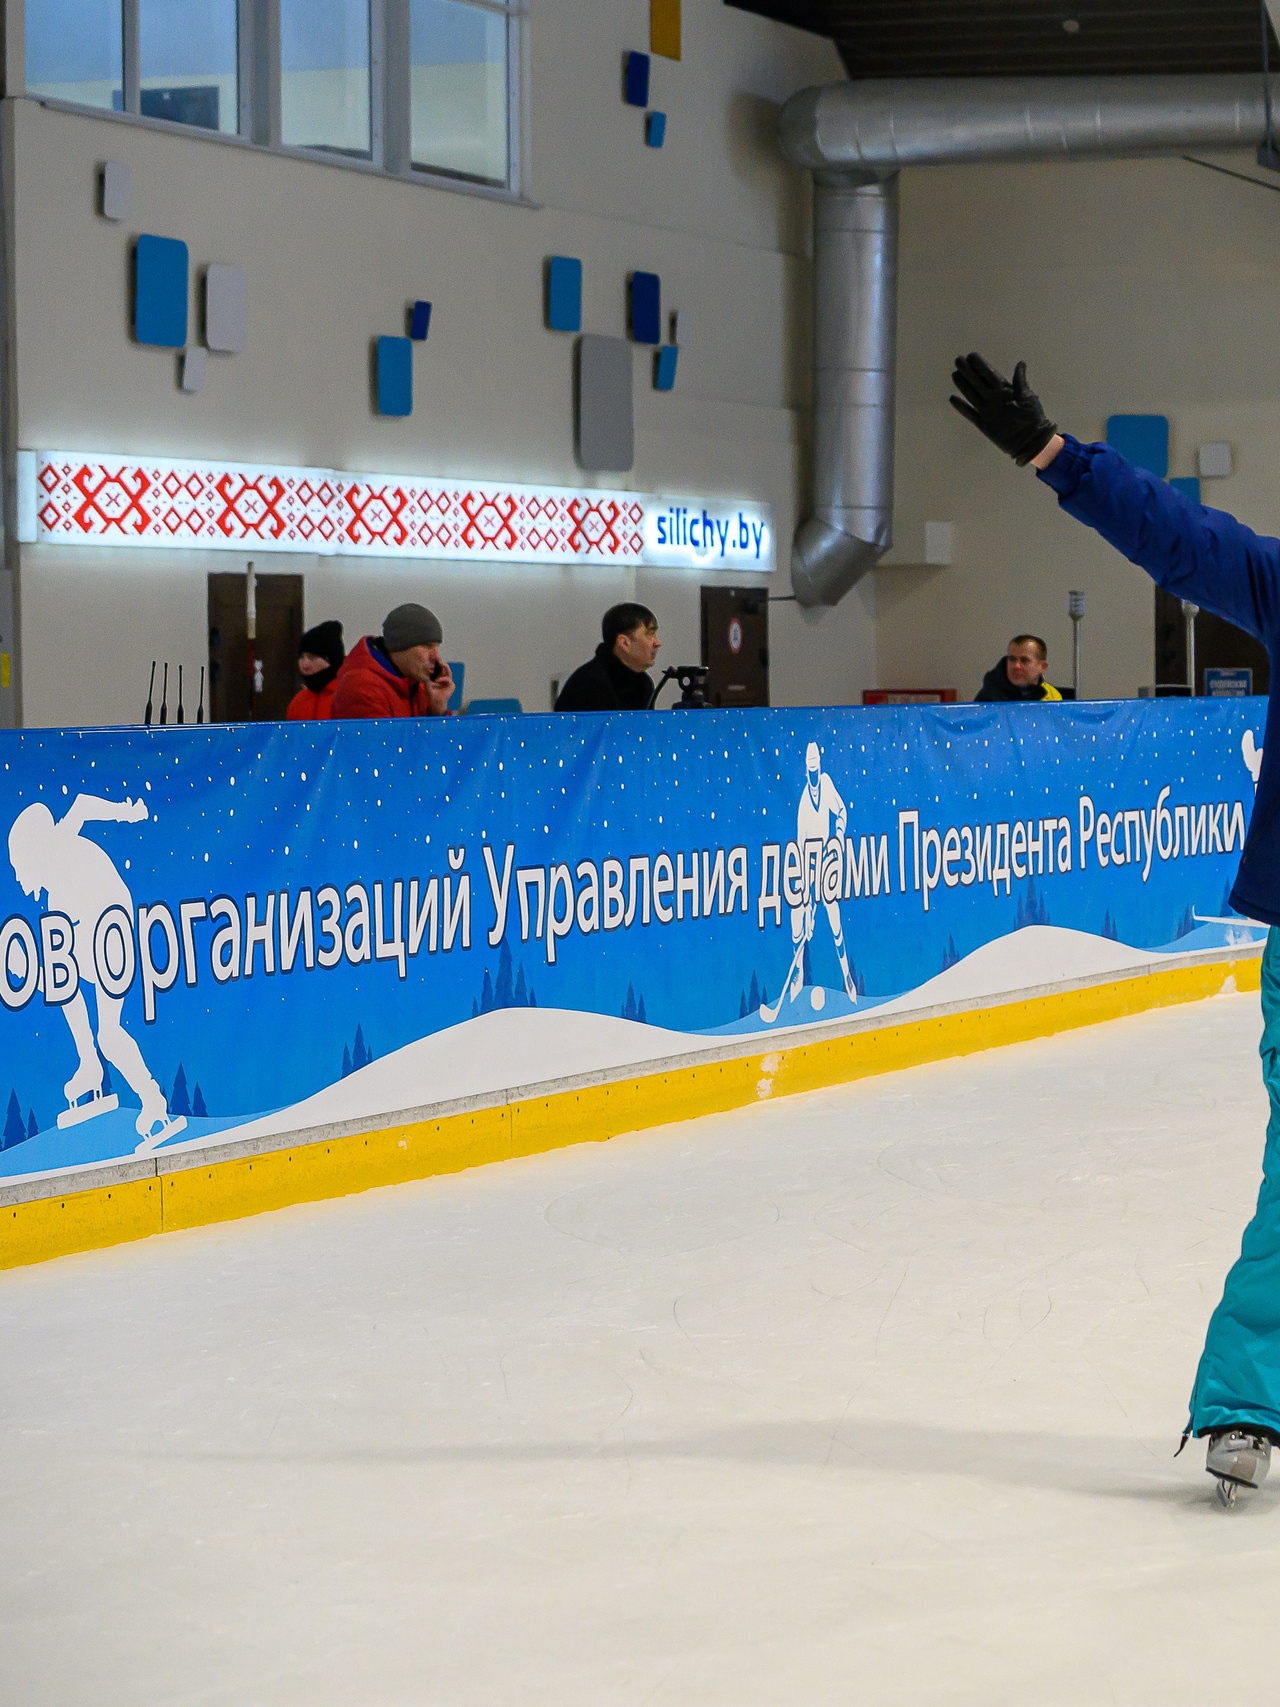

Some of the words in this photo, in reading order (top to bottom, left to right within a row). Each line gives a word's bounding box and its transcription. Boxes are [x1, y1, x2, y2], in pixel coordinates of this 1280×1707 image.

[657, 506, 764, 559] silichy.by
[0, 914, 79, 1009] ов
[95, 847, 472, 1023] организаций
[482, 842, 748, 963] Управления
[758, 833, 891, 928] делами
[898, 808, 1072, 911] Президента
[1078, 784, 1245, 882] Республики
